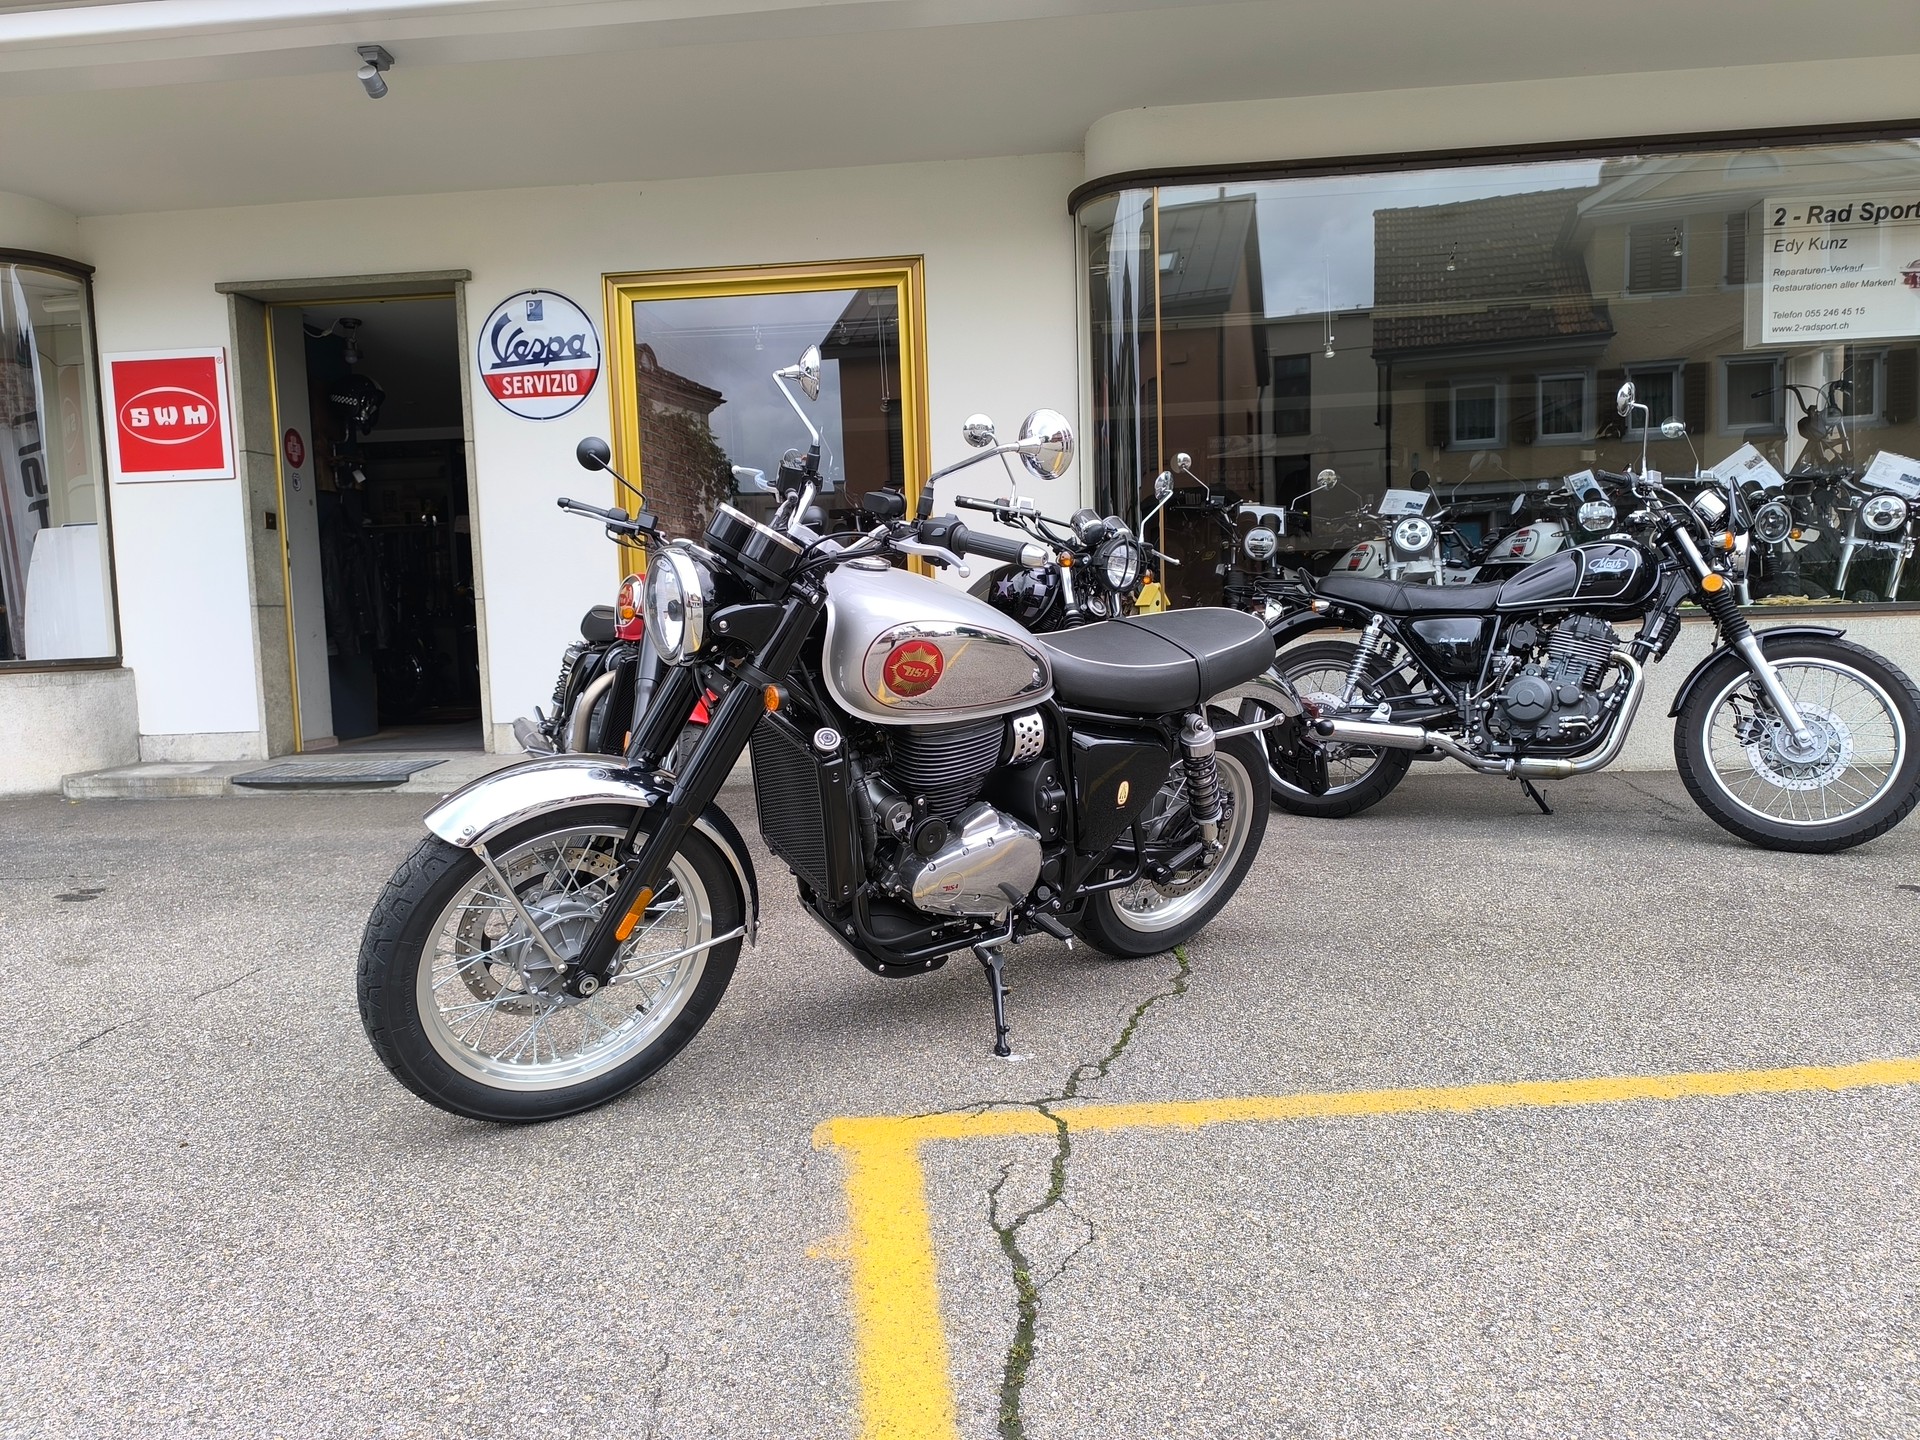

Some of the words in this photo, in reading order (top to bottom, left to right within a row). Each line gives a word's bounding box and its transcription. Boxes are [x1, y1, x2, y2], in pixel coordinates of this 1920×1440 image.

[1773, 207, 1787, 226] 2
[1806, 203, 1854, 225] Rad
[1773, 238, 1804, 255] Edy
[1808, 236, 1849, 251] Kunz
[1772, 263, 1864, 277] Reparaturen-Verkauf
[1772, 282, 1838, 293] Restaurationen
[1839, 281, 1859, 290] aller
[1861, 278, 1897, 288] Marken!
[1772, 311, 1802, 320] Telefon
[1804, 309, 1821, 318] 055
[1823, 308, 1839, 317] 246
[1841, 307, 1852, 316] 45
[1855, 306, 1866, 316] 15
[1771, 321, 1850, 333] www.2-radsport.ch
[490, 312, 592, 369] Vespa
[502, 373, 578, 395] SERVIZIO
[130, 405, 208, 428] SWM
[1592, 557, 1623, 570] Mash
[902, 665, 930, 678] BSA
